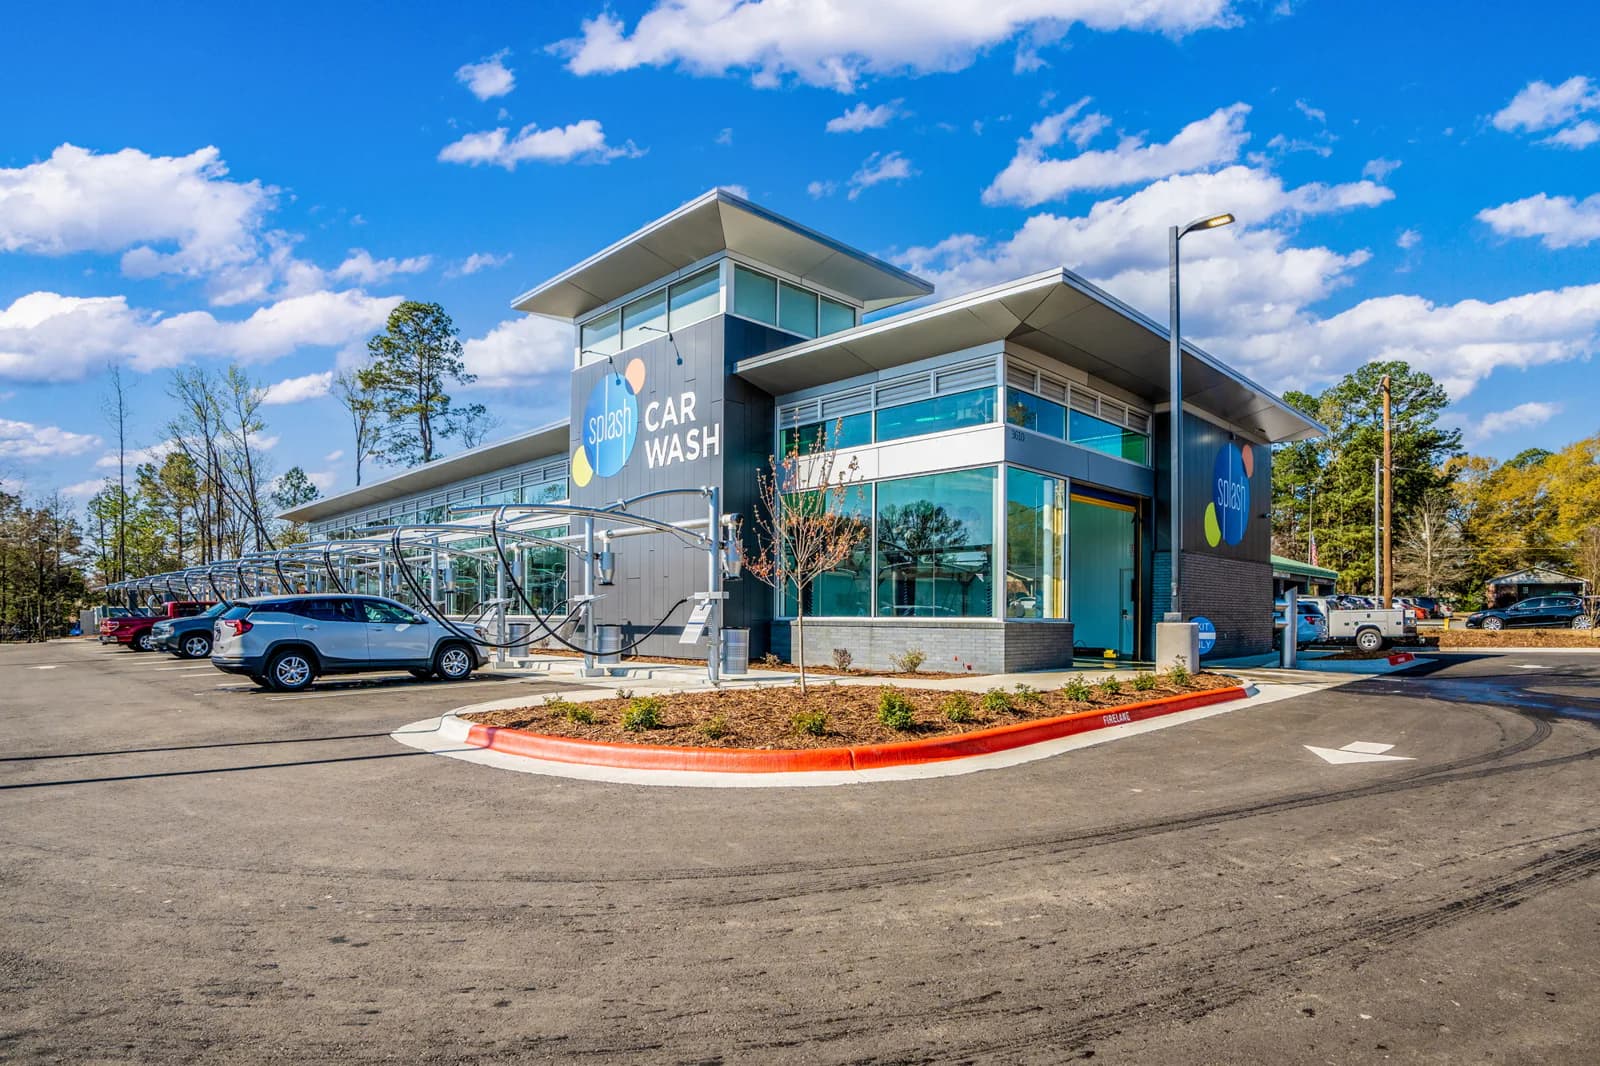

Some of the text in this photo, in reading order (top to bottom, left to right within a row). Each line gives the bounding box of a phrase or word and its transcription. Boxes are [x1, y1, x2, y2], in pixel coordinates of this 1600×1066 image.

[589, 375, 631, 475] splash
[645, 391, 696, 432] CAR
[645, 423, 720, 469] WASH
[1217, 442, 1246, 540] splash
[1198, 640, 1211, 649] LY
